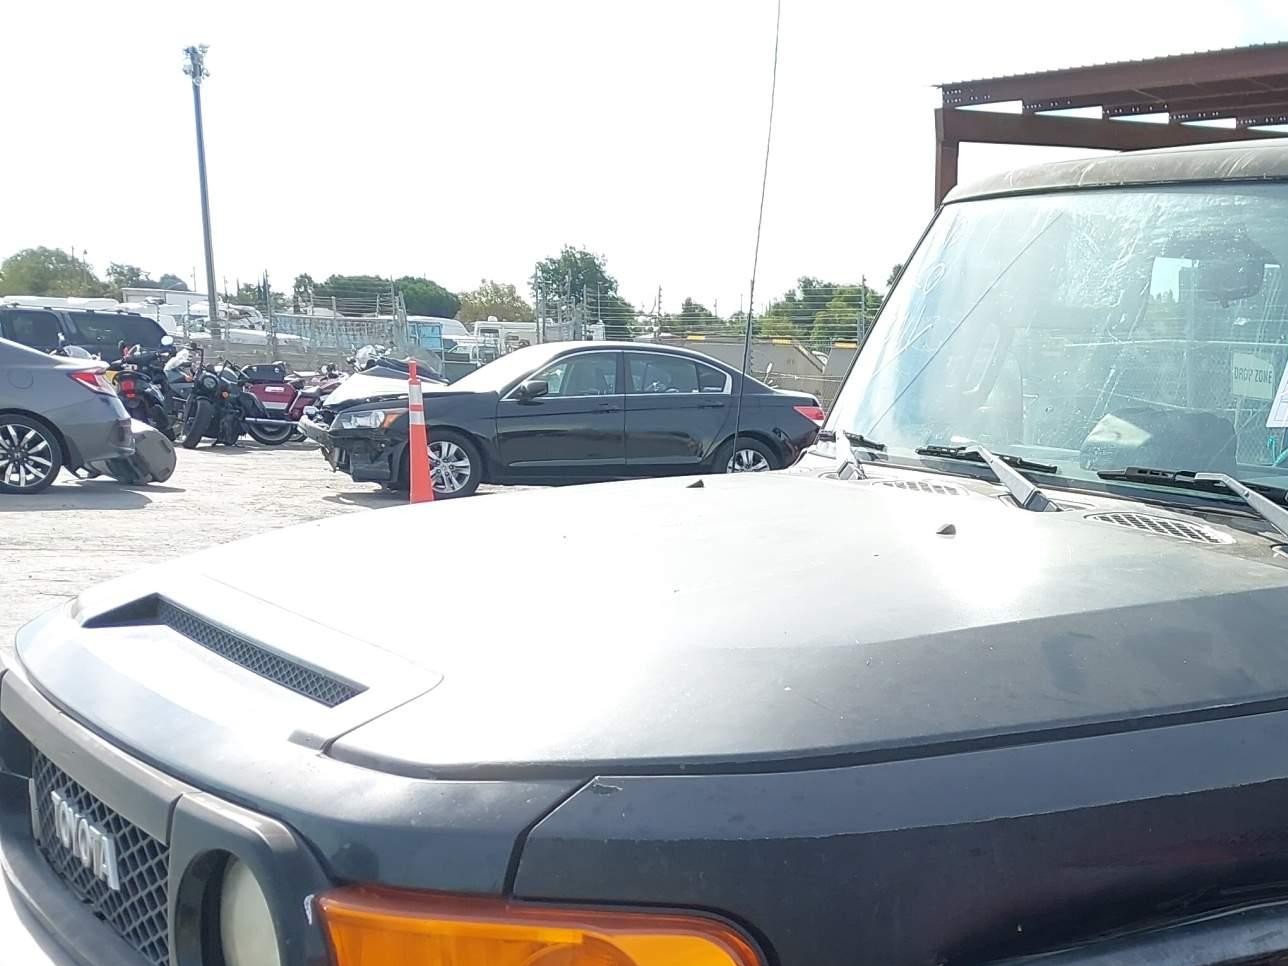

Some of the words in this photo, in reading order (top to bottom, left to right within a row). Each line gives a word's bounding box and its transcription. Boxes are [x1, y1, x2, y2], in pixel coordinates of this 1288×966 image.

[1233, 366, 1254, 383] DROP
[1254, 368, 1273, 385] ZONE
[51, 790, 120, 891] TOYOTA
